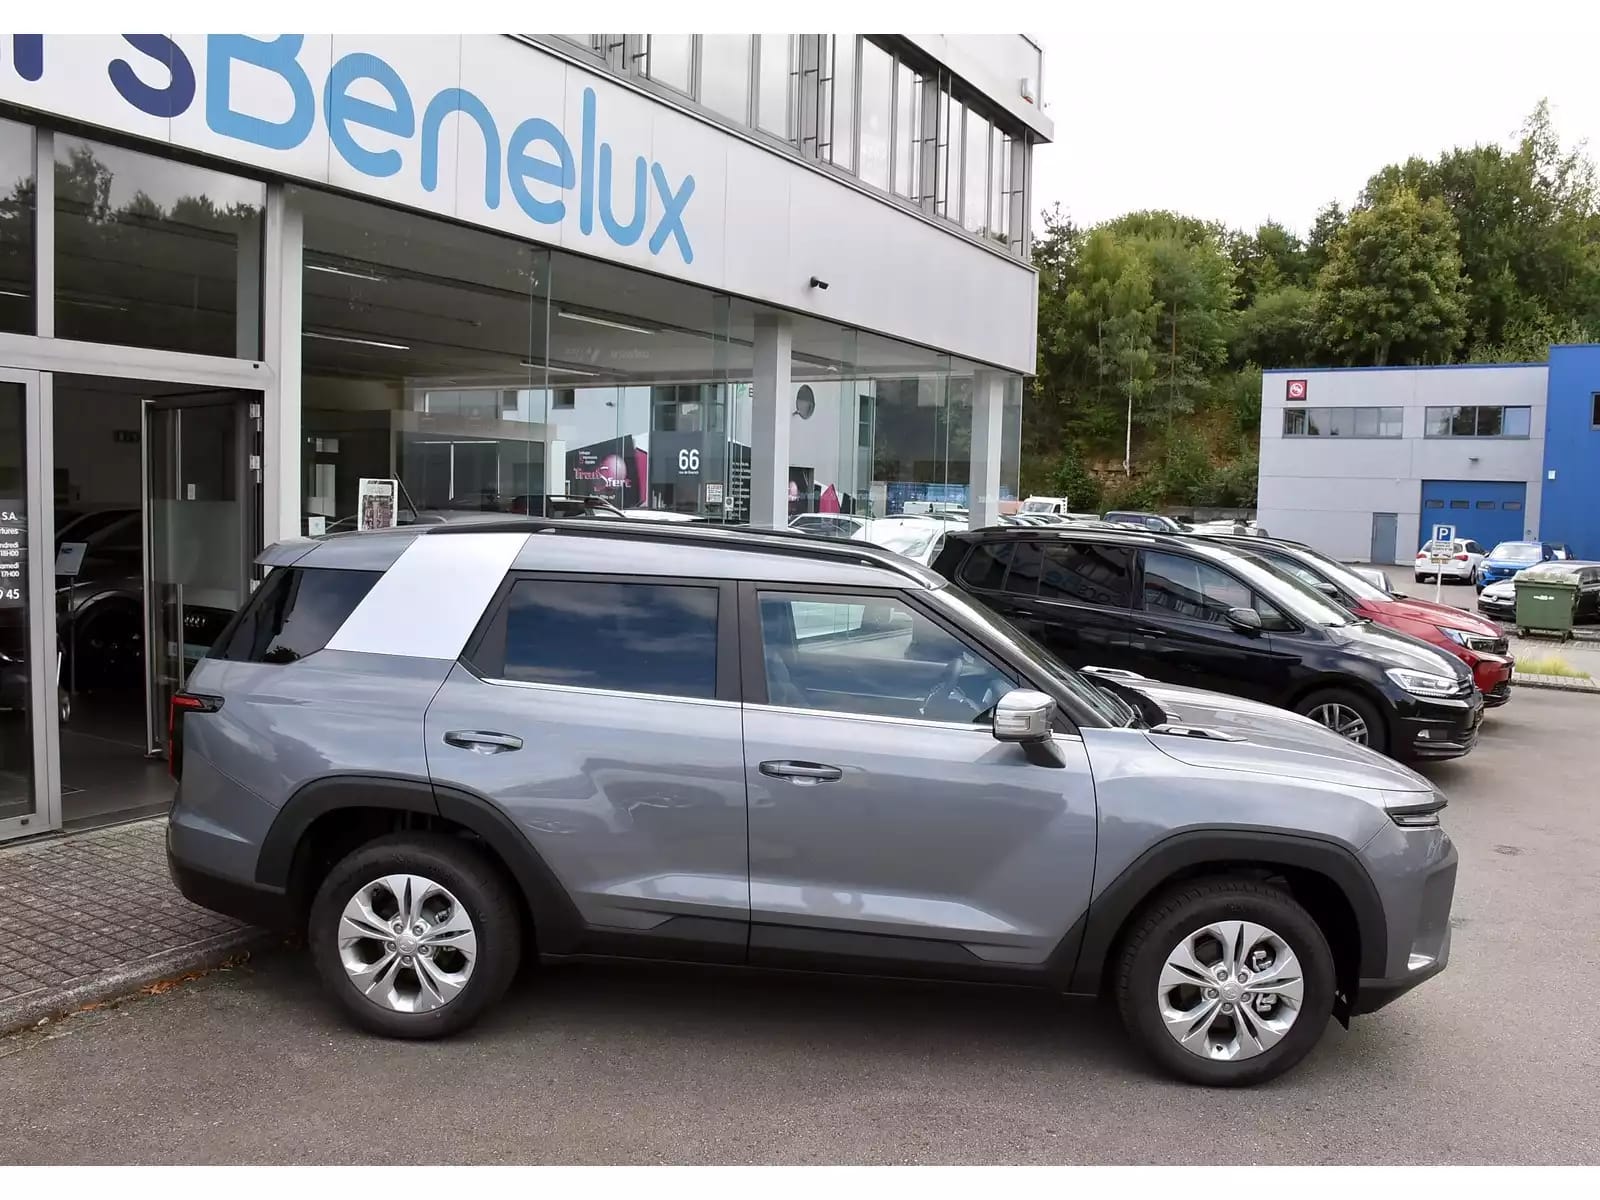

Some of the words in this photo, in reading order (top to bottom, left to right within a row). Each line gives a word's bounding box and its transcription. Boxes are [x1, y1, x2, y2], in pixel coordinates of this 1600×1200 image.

[679, 449, 700, 470] 66
[1439, 528, 1449, 540] P
[6, 588, 20, 599] 45
